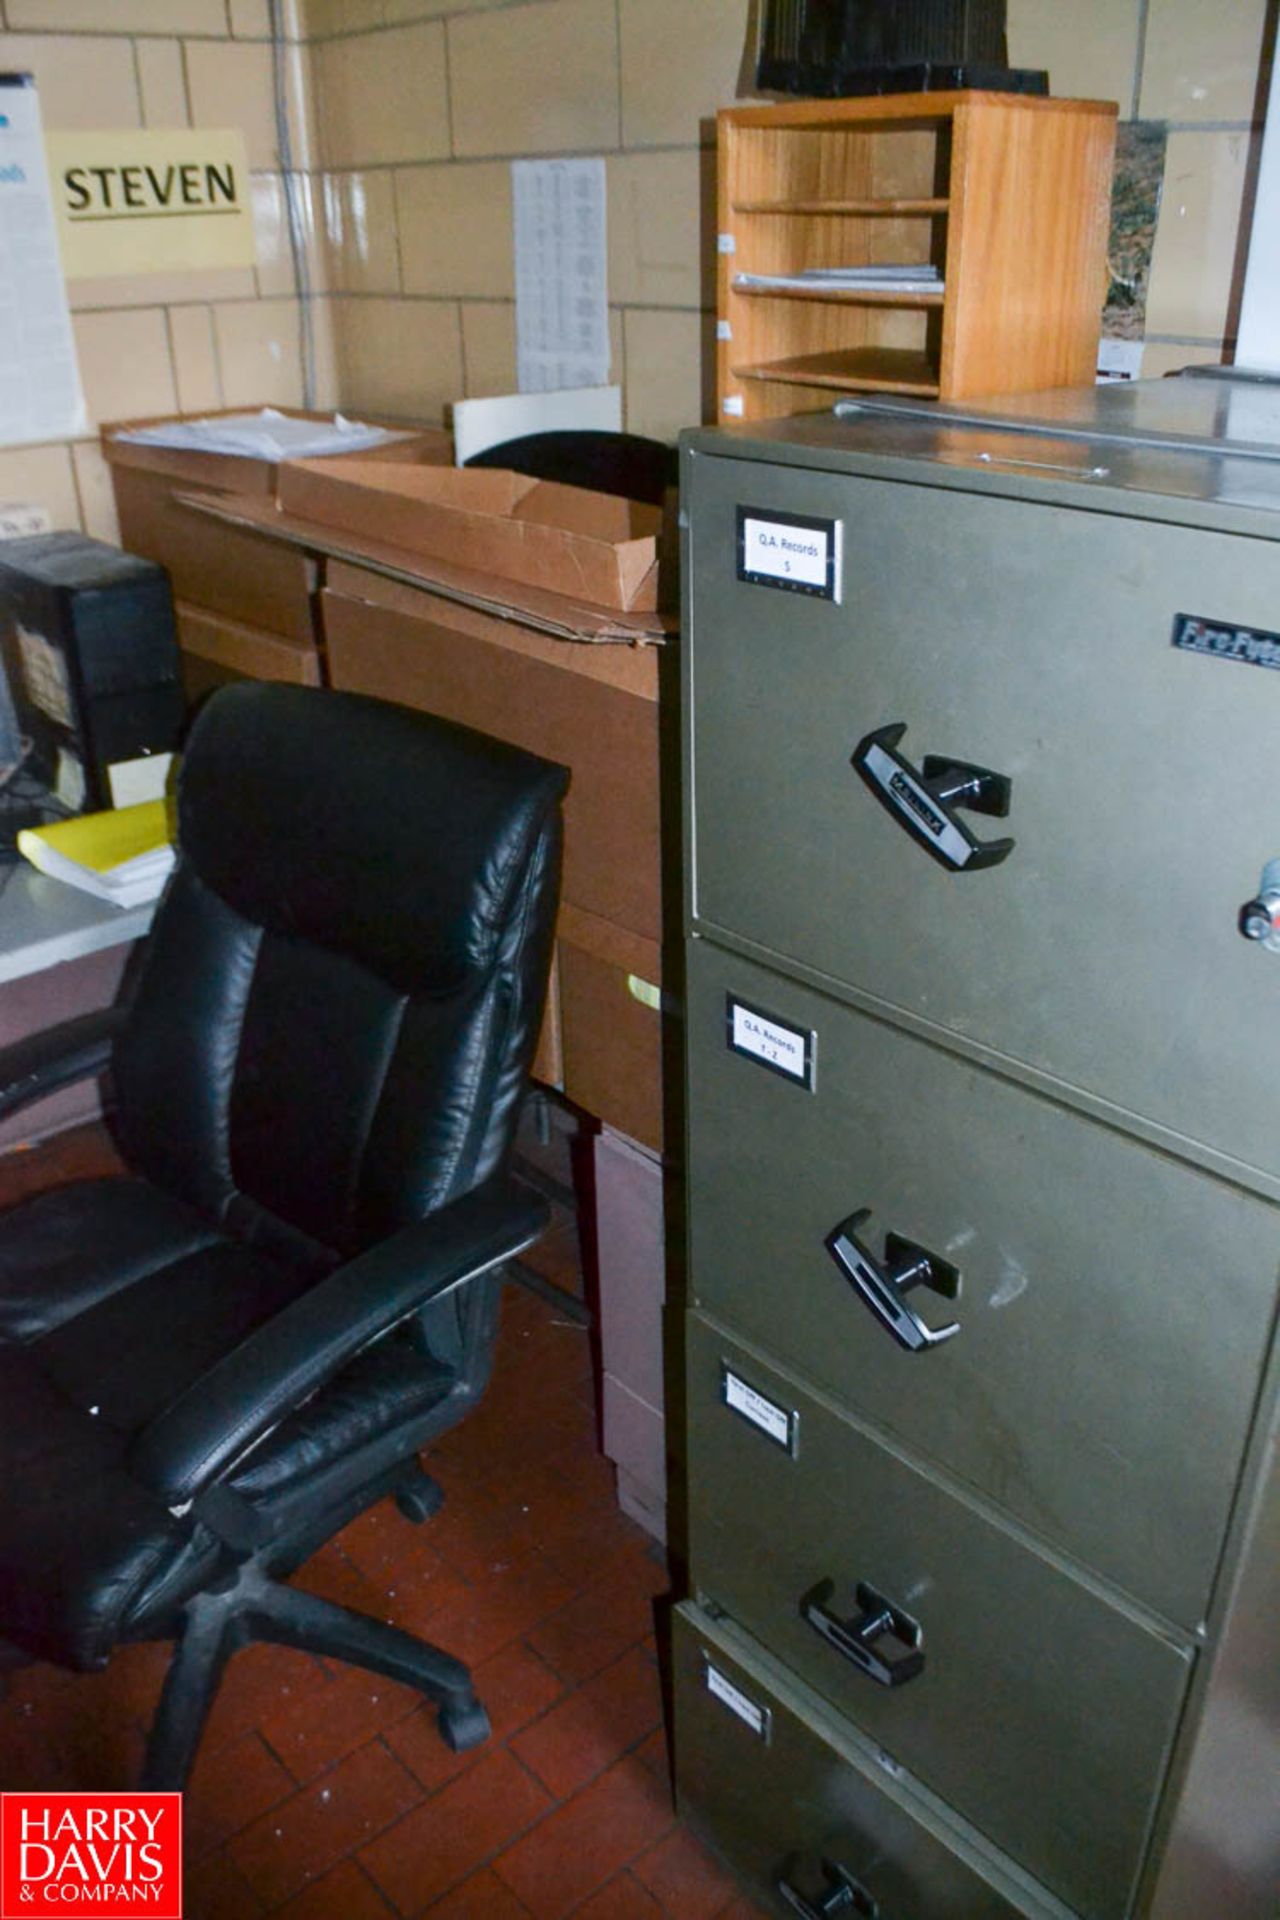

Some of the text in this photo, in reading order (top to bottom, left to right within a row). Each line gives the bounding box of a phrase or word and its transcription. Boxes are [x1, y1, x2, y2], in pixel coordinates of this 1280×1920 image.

[64, 163, 237, 211] STEVEN
[781, 538, 819, 557] Records
[763, 1030, 796, 1054] Records
